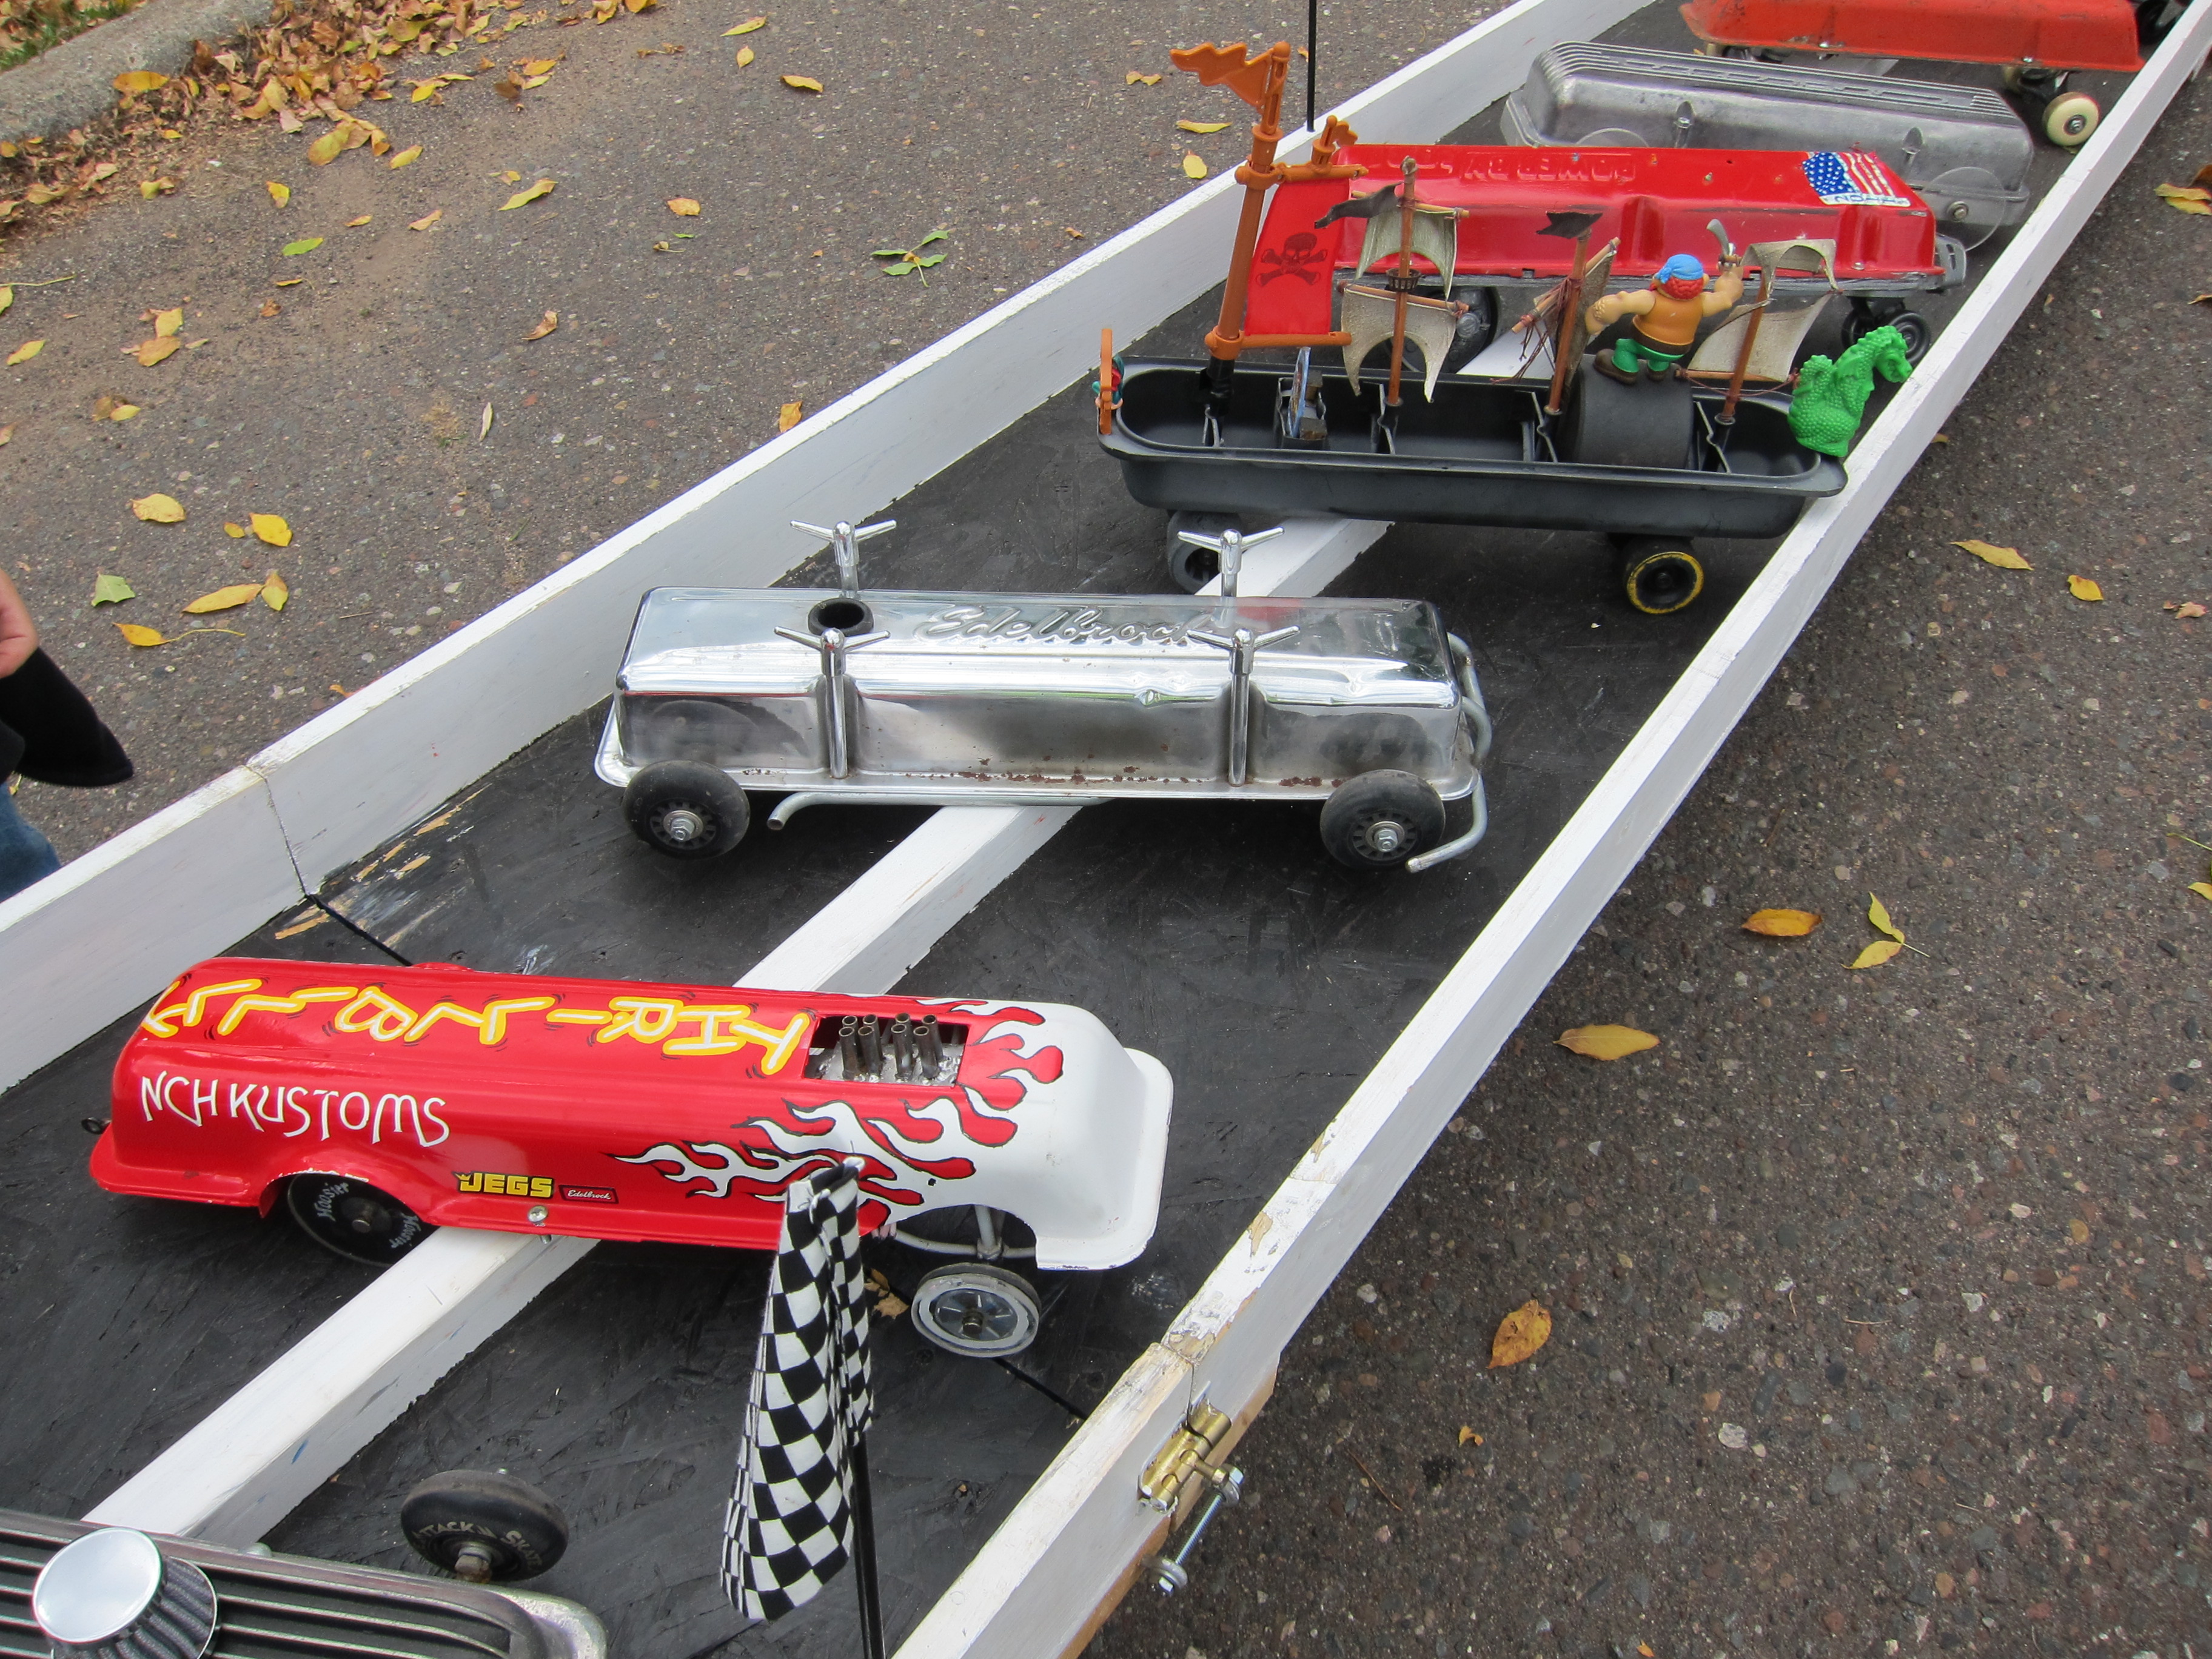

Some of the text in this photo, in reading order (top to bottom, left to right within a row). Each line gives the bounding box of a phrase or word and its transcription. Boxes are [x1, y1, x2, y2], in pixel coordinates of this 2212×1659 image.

[229, 1082, 450, 1147] KUSTOMS
[459, 1172, 552, 1198] JEGS
[567, 1189, 612, 1201] Edelbrock
